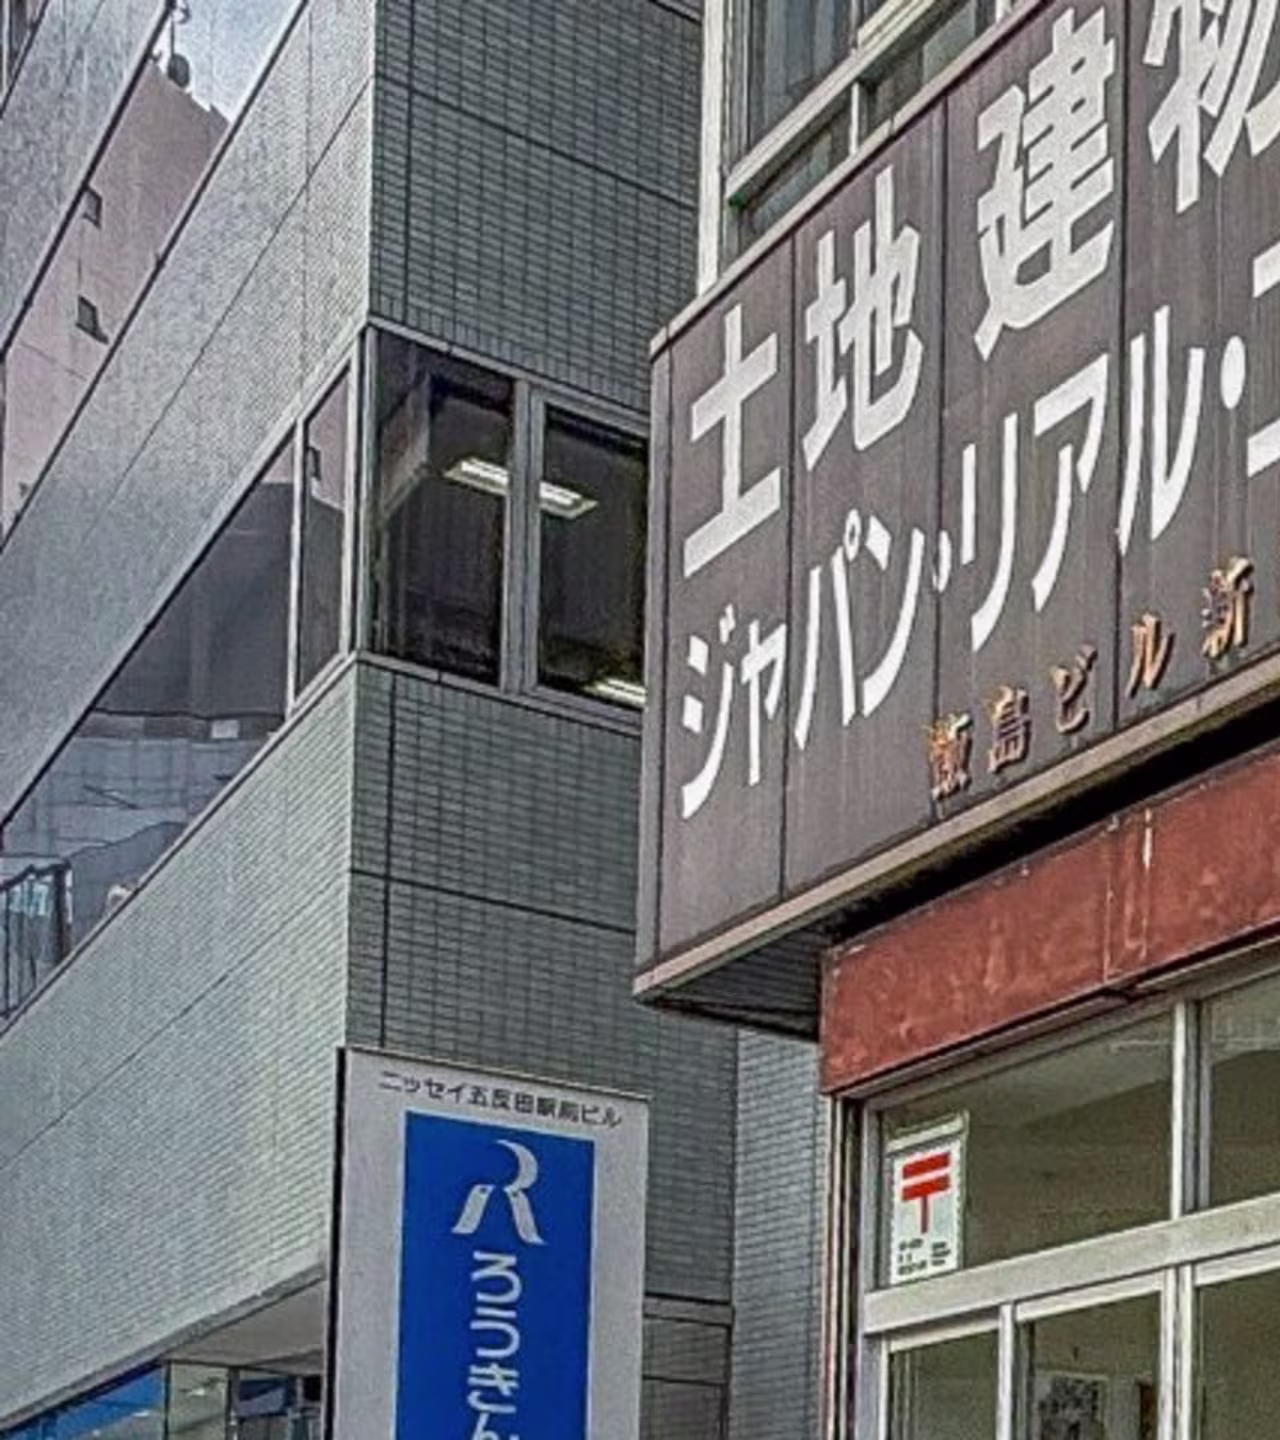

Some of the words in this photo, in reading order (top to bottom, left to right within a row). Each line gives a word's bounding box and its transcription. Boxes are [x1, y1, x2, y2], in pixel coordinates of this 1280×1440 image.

[379, 1070, 623, 1128] ニッセイ五反田駅前ビル
